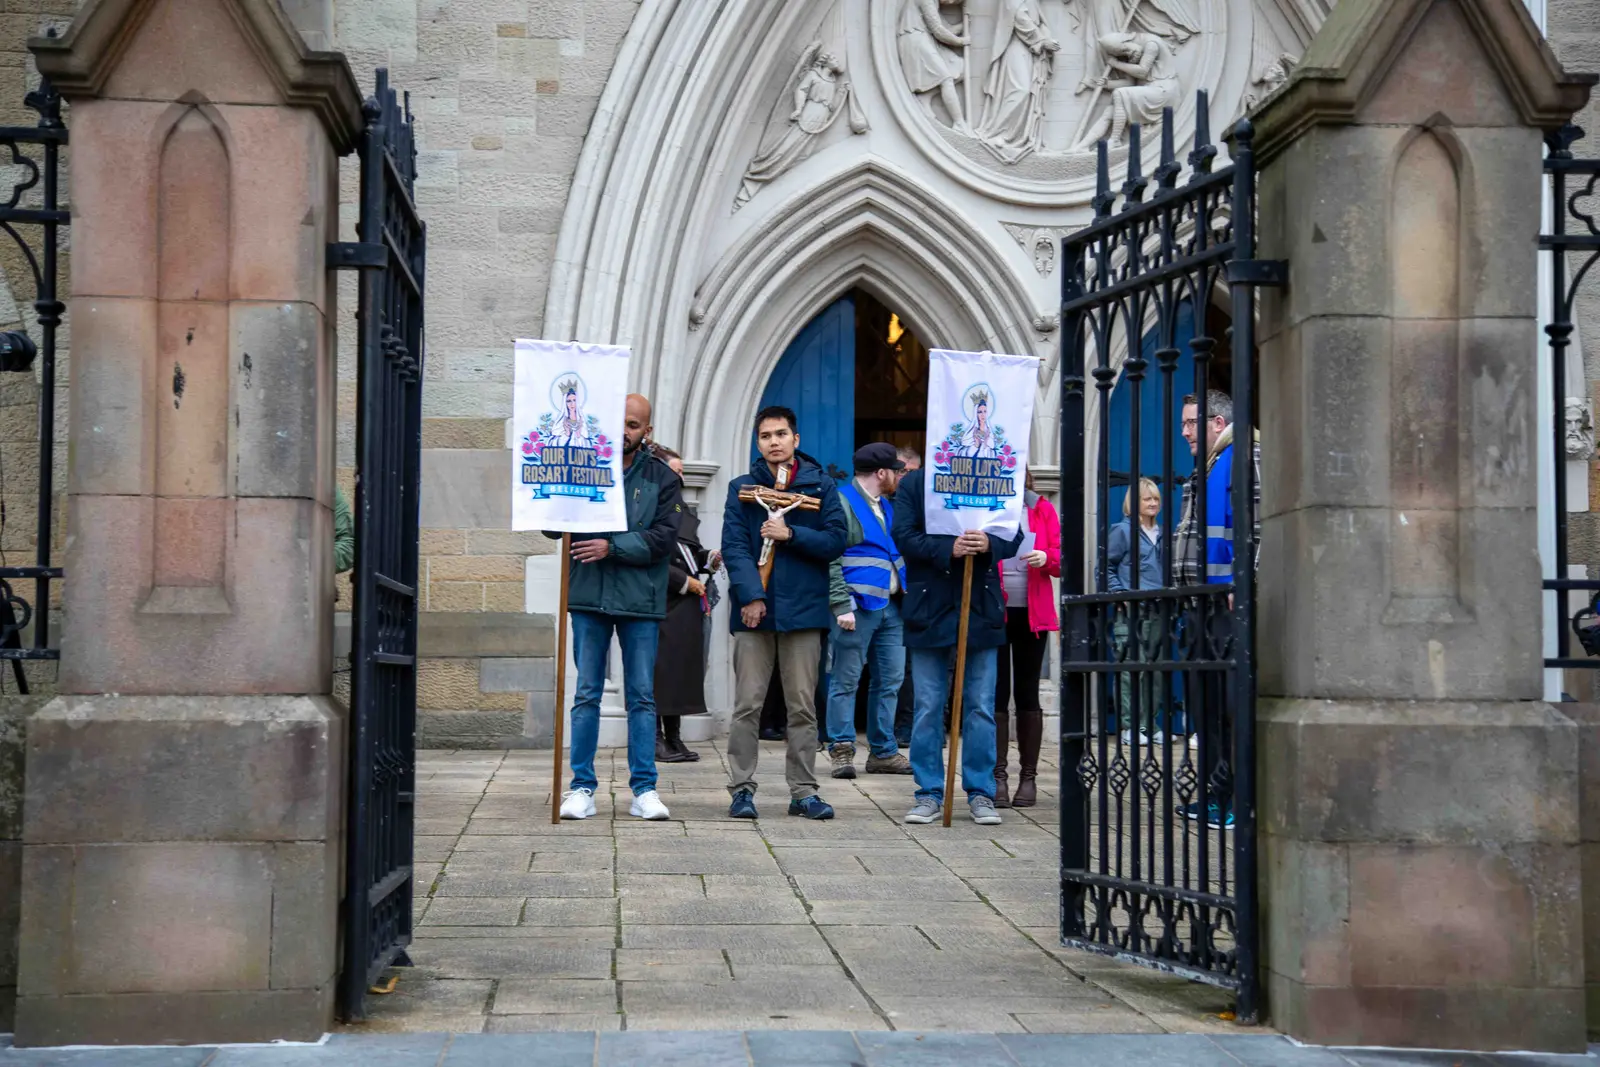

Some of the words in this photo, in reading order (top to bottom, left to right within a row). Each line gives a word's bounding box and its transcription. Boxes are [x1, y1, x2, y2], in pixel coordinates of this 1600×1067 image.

[542, 448, 565, 465] OUR
[951, 457, 973, 475] OUR
[523, 465, 569, 483] ROSARY
[571, 467, 614, 486] FESTIVAL
[935, 475, 975, 493] ROSARY
[550, 485, 590, 495] BELFAST
